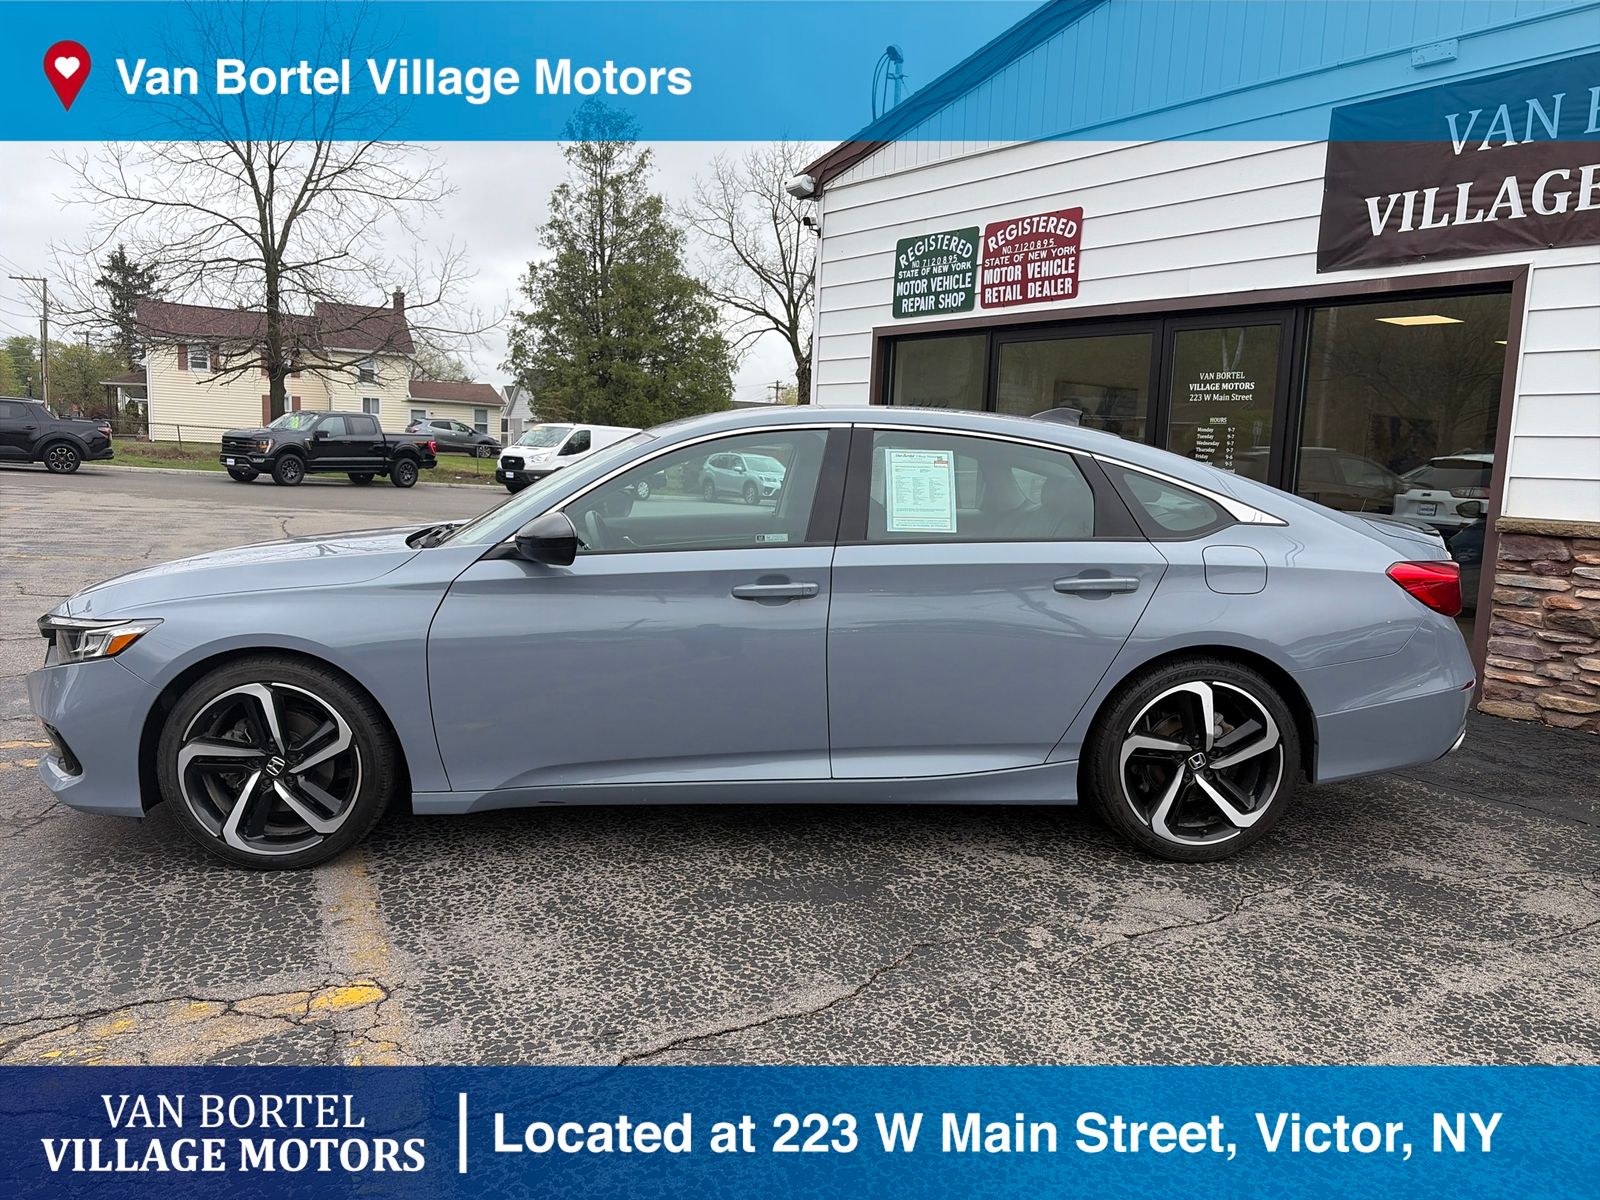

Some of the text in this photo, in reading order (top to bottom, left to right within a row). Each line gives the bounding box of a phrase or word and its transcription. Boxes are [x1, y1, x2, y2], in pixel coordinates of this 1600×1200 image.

[1444, 92, 1566, 156] VAN
[1364, 163, 1600, 237] VILLAGE
[987, 216, 1077, 253] REGISTERED
[1014, 238, 1055, 252] 7120895
[899, 234, 973, 269] REGISTERED
[922, 254, 959, 268] 7120895
[984, 245, 1076, 267] STATE OF NEW YORK
[898, 261, 972, 279] STATE OF NEW YORK
[984, 257, 1076, 285] MOTOR VEHICLE
[896, 272, 973, 297] MOTOR VEHICLE
[985, 277, 1073, 304] RETAIL DEALER
[902, 291, 966, 313] REPAIR SHOP
[1189, 382, 1255, 391] VILLAGE MOTORS
[1199, 371, 1246, 380] VAN BORTEL
[1189, 392, 1253, 402] 223 W Main Street
